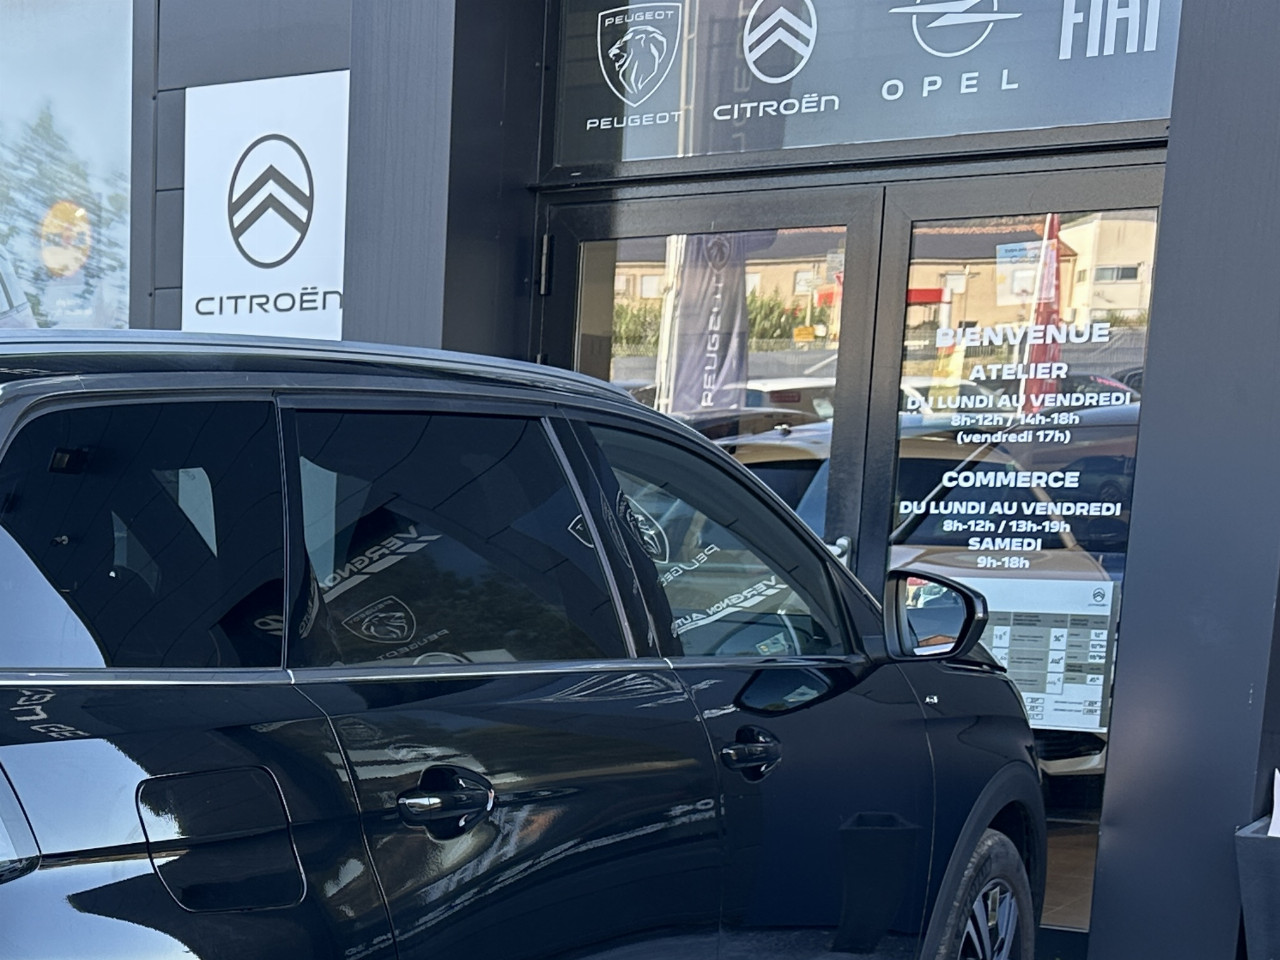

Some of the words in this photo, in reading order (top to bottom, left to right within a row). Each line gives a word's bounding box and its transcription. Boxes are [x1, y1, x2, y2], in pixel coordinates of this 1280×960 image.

[604, 10, 674, 27] PEUGEOT
[881, 69, 1019, 101] OPEL
[586, 111, 683, 131] PEUGEOT
[935, 322, 1111, 348] BIENVENUE
[969, 362, 1069, 381] ATELIER
[906, 396, 932, 410] DU
[937, 395, 993, 409] LUNDI
[997, 394, 1025, 408] AU
[1029, 392, 1131, 407] VENDREDI
[950, 413, 1003, 427] 8h-12h
[1020, 412, 1080, 426] 14h-18h
[956, 430, 1033, 445] (vendredi
[1036, 429, 1071, 444] 17h)
[942, 471, 1080, 488] COMMERCE
[899, 500, 926, 514] DU
[929, 501, 985, 515] LUNDI
[989, 501, 1018, 515] AU
[1021, 502, 1122, 516] VENDREDI
[942, 520, 995, 532] 8h-12h
[1009, 520, 1070, 533] 13h-19h
[968, 537, 1042, 551] SAMEDI
[977, 556, 1030, 568] 9h-18h
